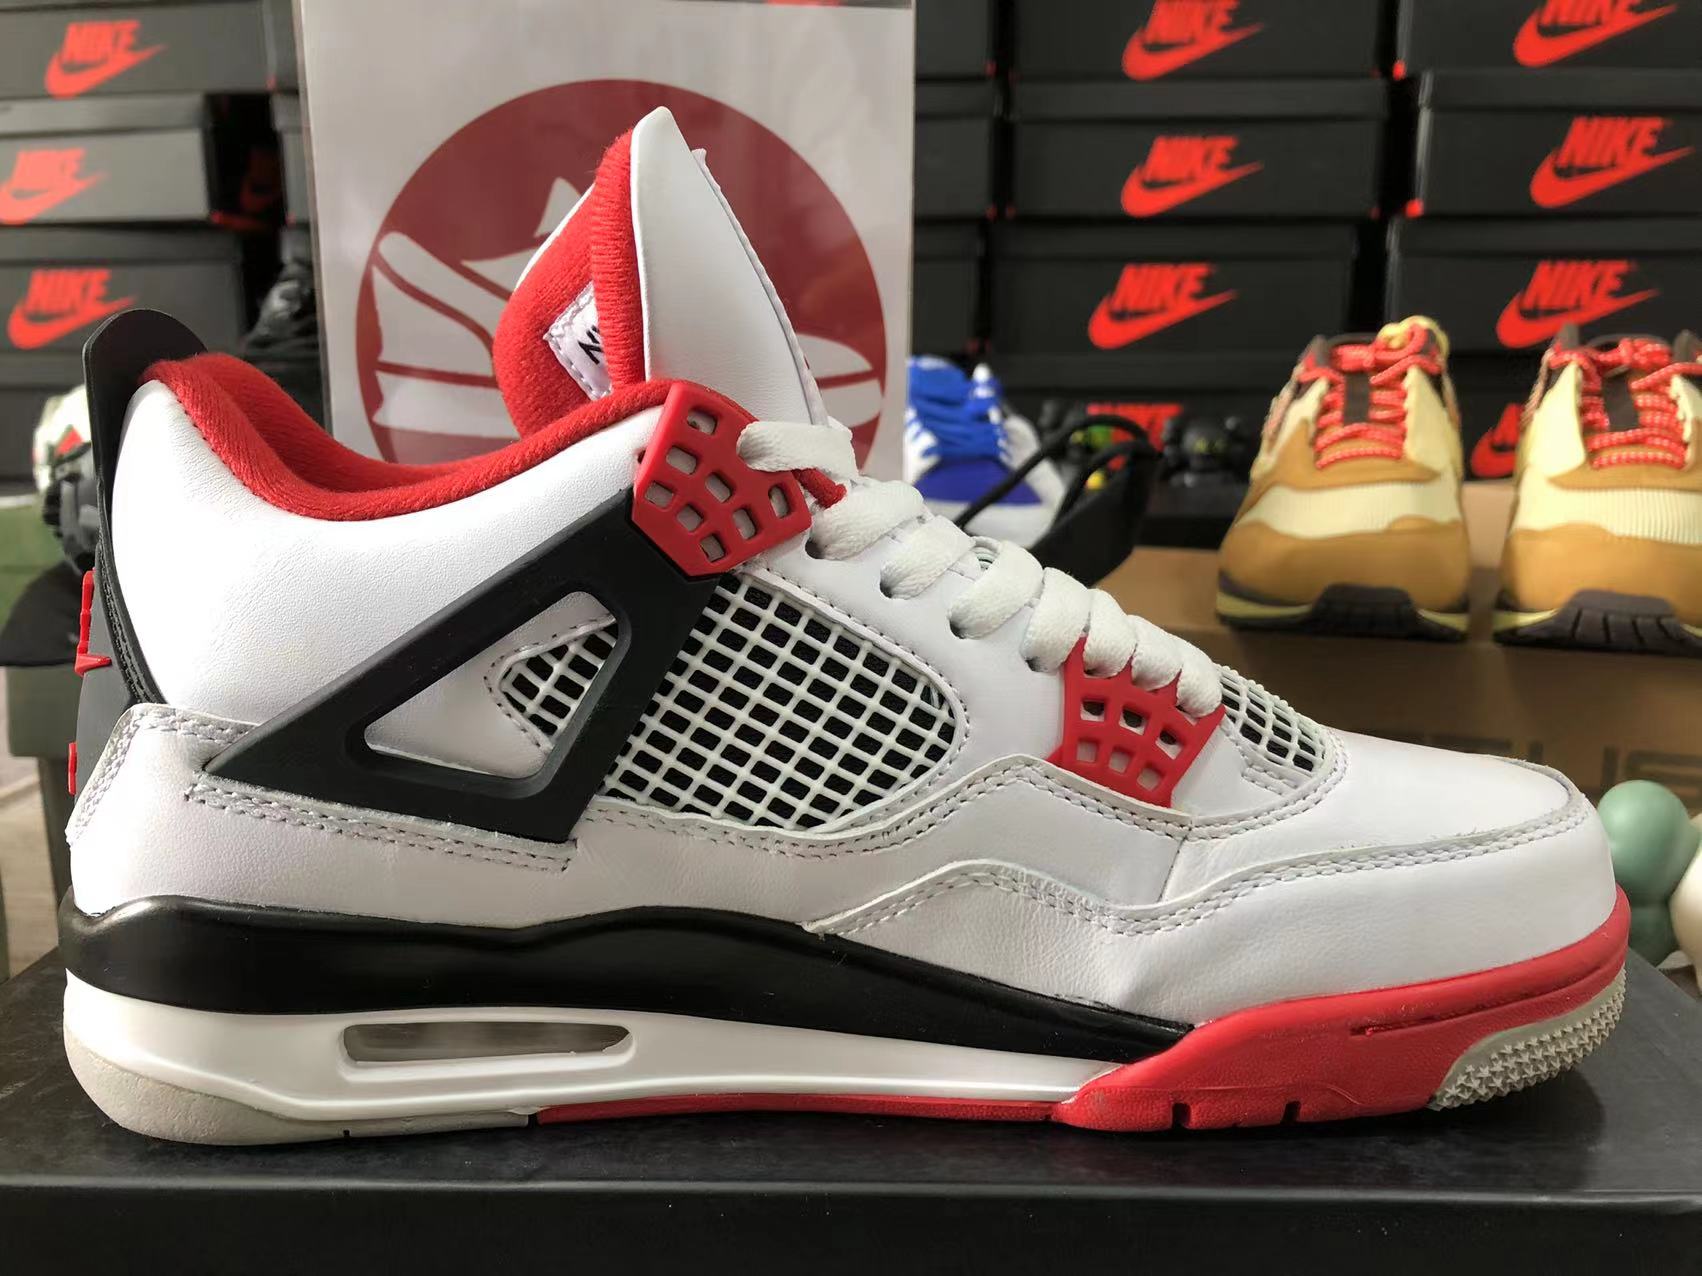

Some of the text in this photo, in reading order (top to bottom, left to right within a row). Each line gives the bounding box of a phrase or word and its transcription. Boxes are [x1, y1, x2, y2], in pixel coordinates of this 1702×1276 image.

[61, 20, 140, 65] NIKE
[1144, 0, 1240, 45] NIKE
[1143, 135, 1239, 183] NIKE
[1557, 117, 1670, 169] NIKE
[11, 148, 86, 190] NIKE
[25, 267, 112, 313] NIKE
[1112, 263, 1214, 314] NIKE
[1523, 260, 1637, 312] NIKE
